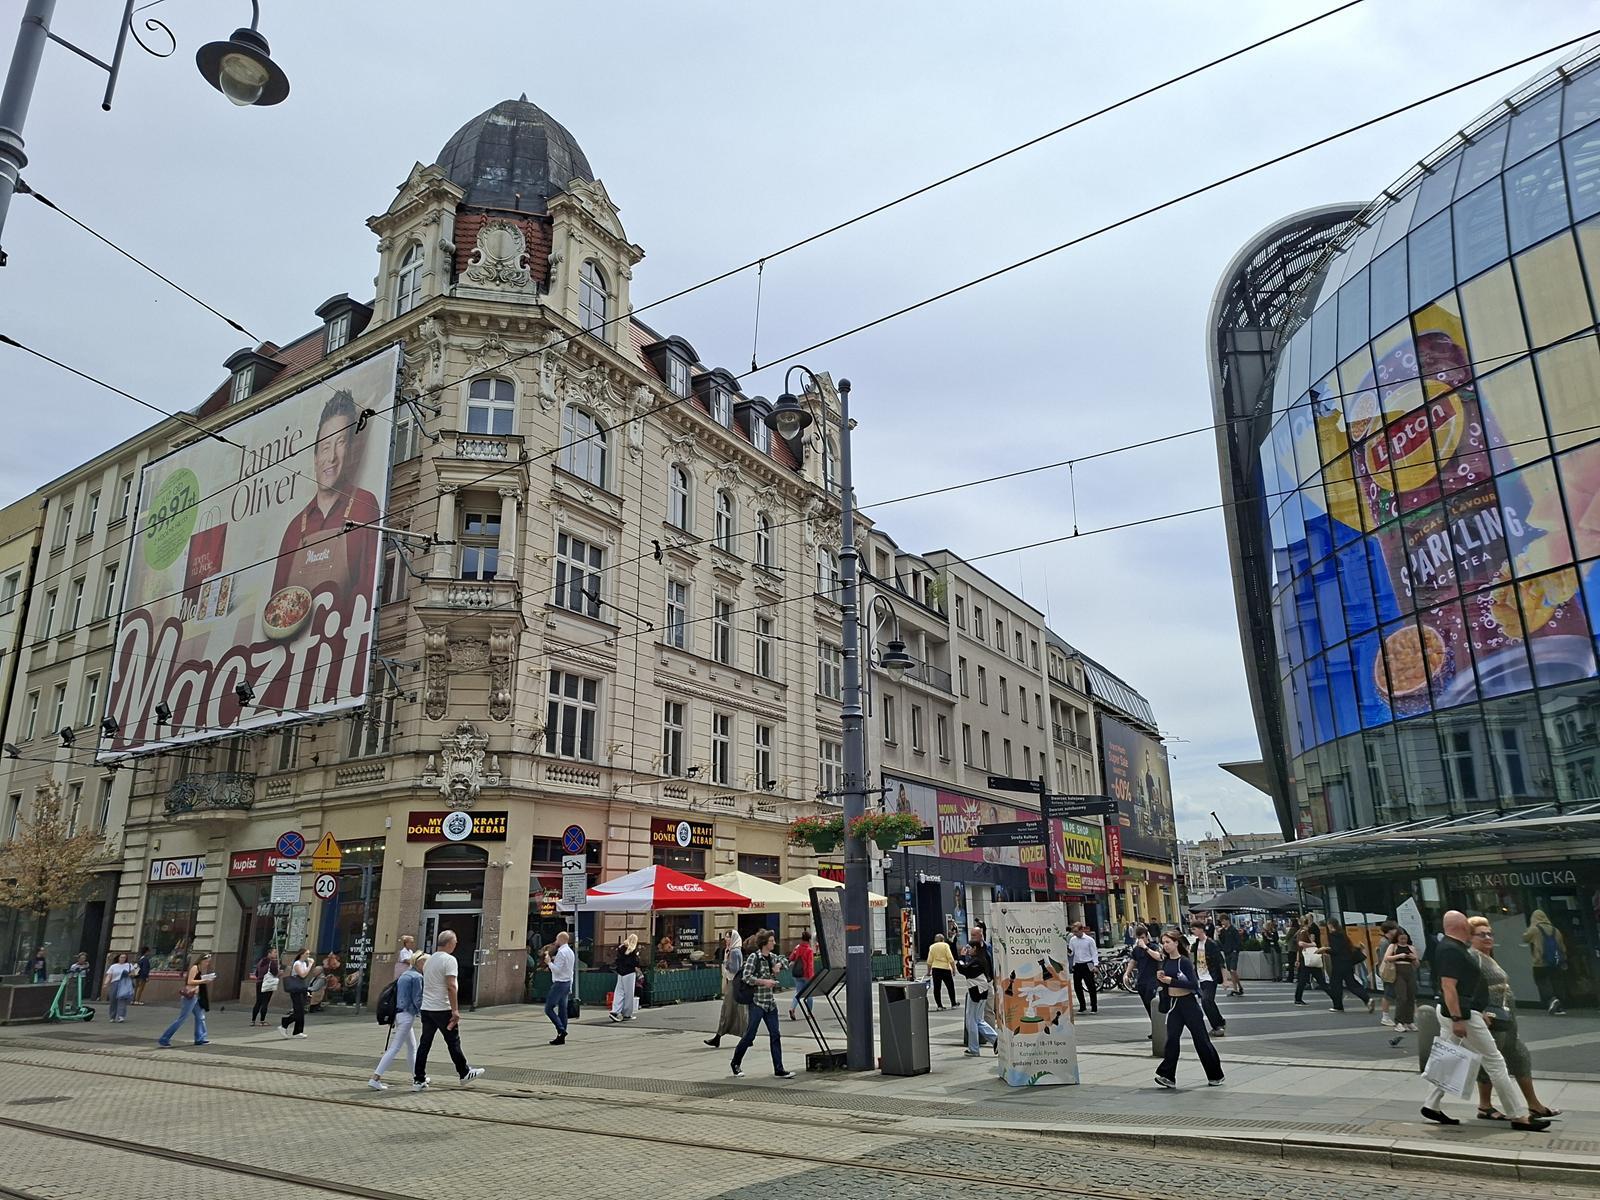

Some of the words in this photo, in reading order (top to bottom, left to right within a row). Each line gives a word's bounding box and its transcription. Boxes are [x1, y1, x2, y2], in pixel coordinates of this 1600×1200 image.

[238, 425, 303, 482] Jamie
[231, 470, 302, 522] Oliver
[1451, 493, 1497, 515] LAVOUR
[1432, 568, 1456, 590] ICE
[1460, 552, 1492, 570] TEA
[100, 591, 372, 751] Maczfit
[428, 818, 442, 826] MY
[473, 817, 506, 825] KRAFT
[939, 815, 965, 834] TANIA
[408, 824, 442, 834] DÖNER
[472, 826, 506, 834] KEBAB
[667, 824, 676, 832] MY
[692, 826, 713, 836] KRAFT
[1076, 825, 1089, 836] SHOP
[692, 835, 714, 845] KEBAB
[941, 834, 973, 854] ODZIE
[1064, 837, 1092, 860] WUJO
[1111, 834, 1121, 868] APTEKA
[180, 861, 193, 876] TU
[232, 859, 257, 872] kupisz
[1485, 870, 1577, 886] KATOWICKA
[317, 879, 335, 893] 20
[751, 901, 765, 909] YSKIE
[1006, 925, 1052, 936] Wakacyjne
[1009, 936, 1051, 947] Rozgrywki
[1011, 946, 1052, 955] Szachowe
